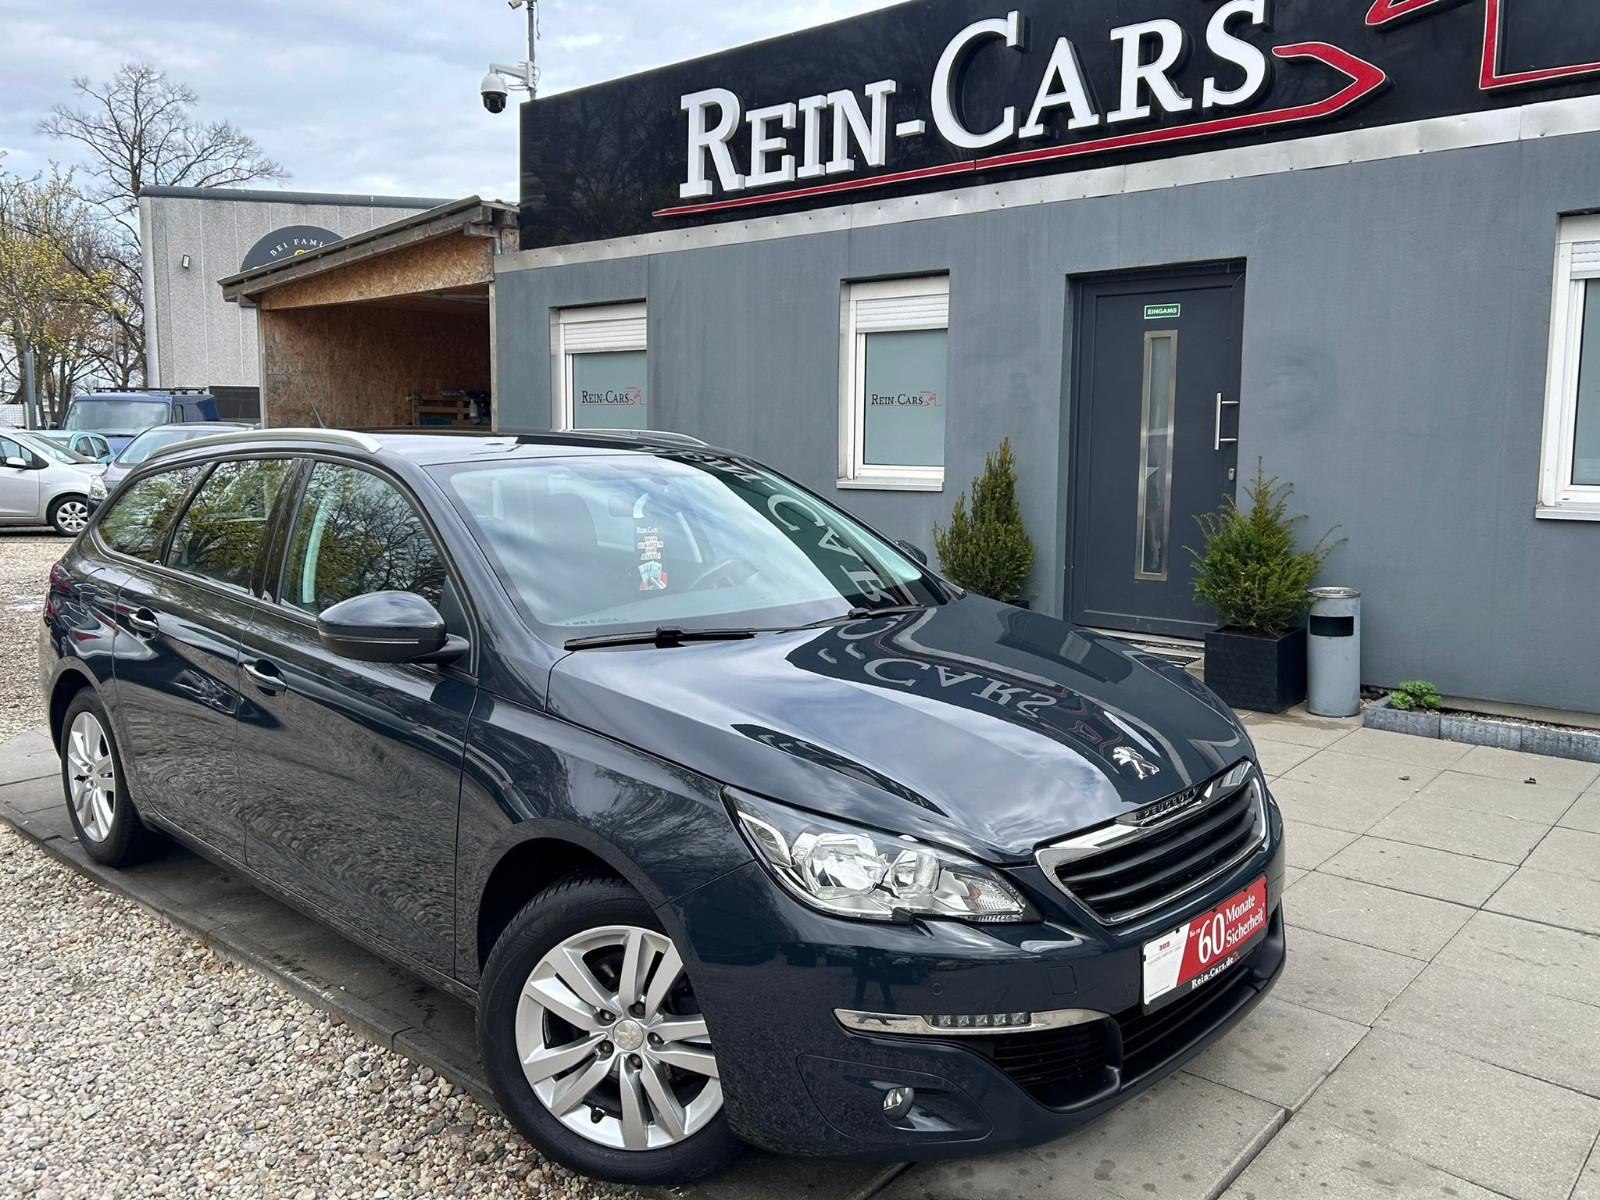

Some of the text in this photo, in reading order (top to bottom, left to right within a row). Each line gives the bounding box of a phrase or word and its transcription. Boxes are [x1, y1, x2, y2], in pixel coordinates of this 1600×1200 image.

[269, 242, 289, 257] BEI
[1198, 913, 1225, 964] 60
[1226, 894, 1256, 925] Monate
[1191, 956, 1234, 989] Rein-Cars.de
